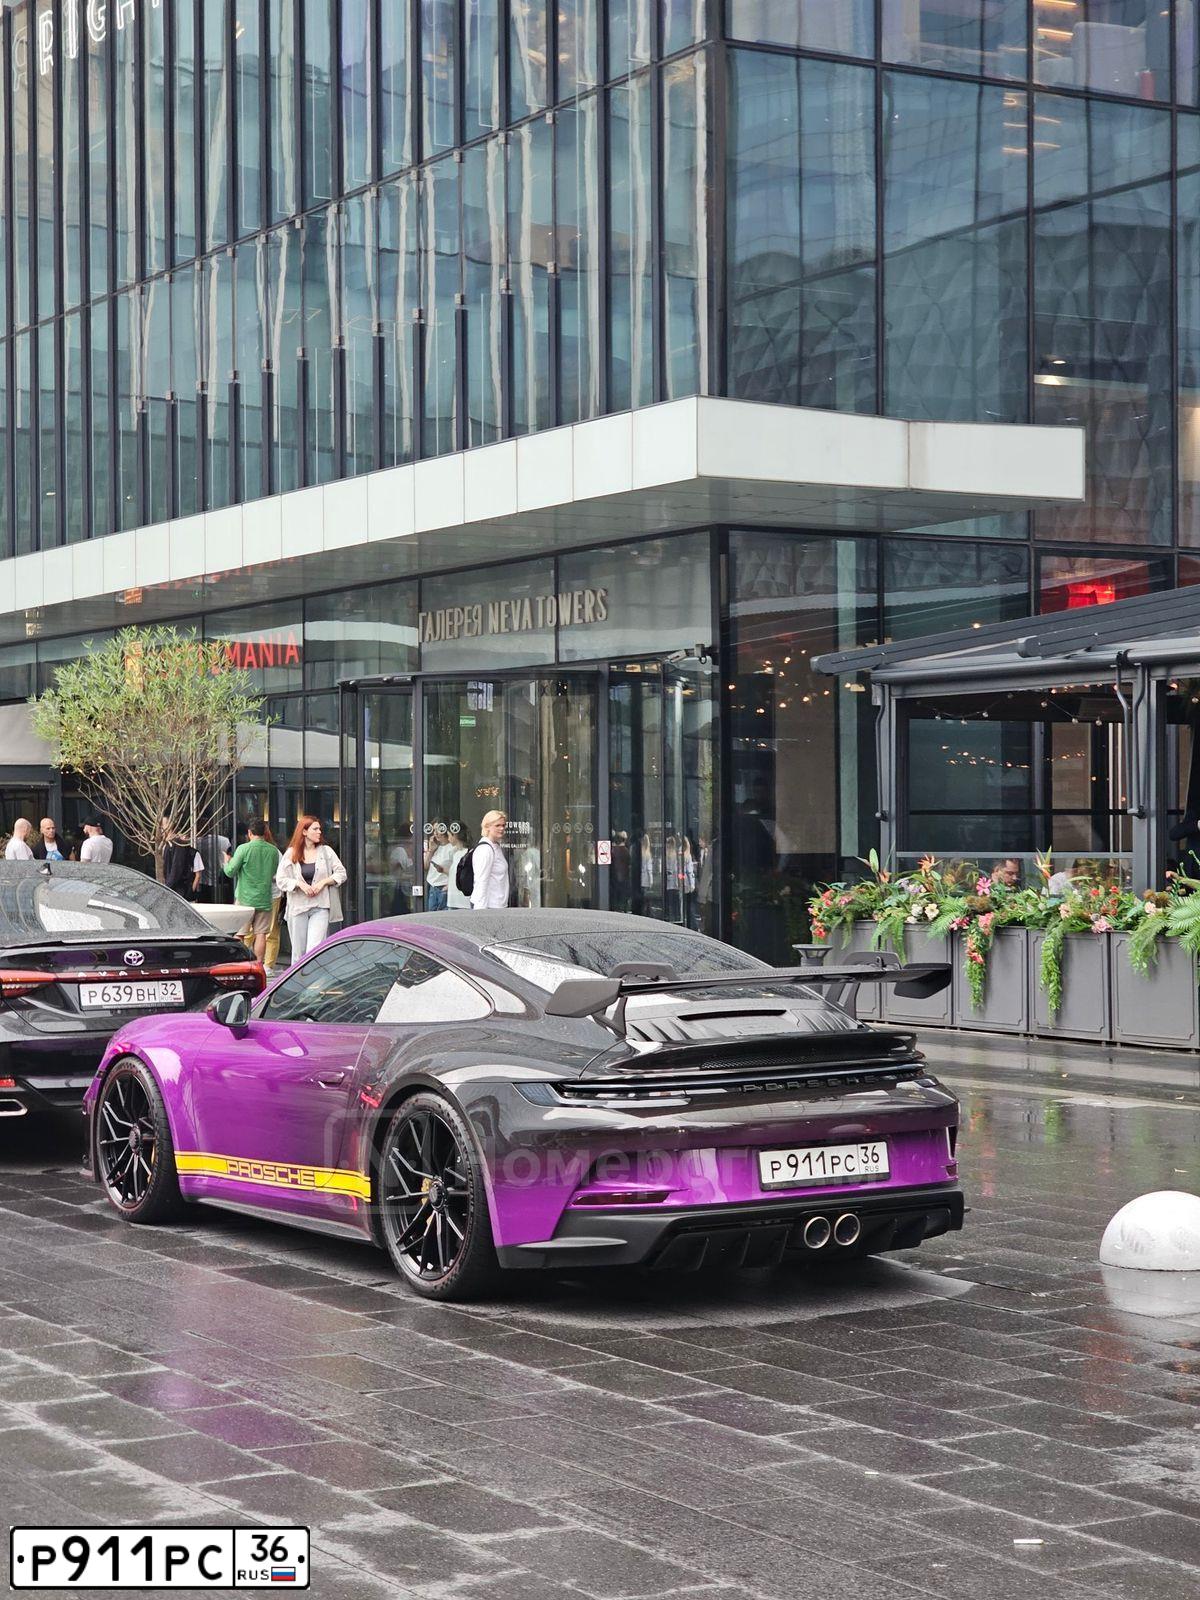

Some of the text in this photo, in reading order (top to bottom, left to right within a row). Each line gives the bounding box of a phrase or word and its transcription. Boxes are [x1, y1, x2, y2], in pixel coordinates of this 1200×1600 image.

[418, 588, 609, 643] ГАЛЕРЕЯ NEVA TOWERS
[78, 968, 189, 977] AVALON
[161, 983, 177, 996] 32
[743, 1075, 877, 1092] PORSCHE
[770, 1145, 880, 1179] P911PC 36
